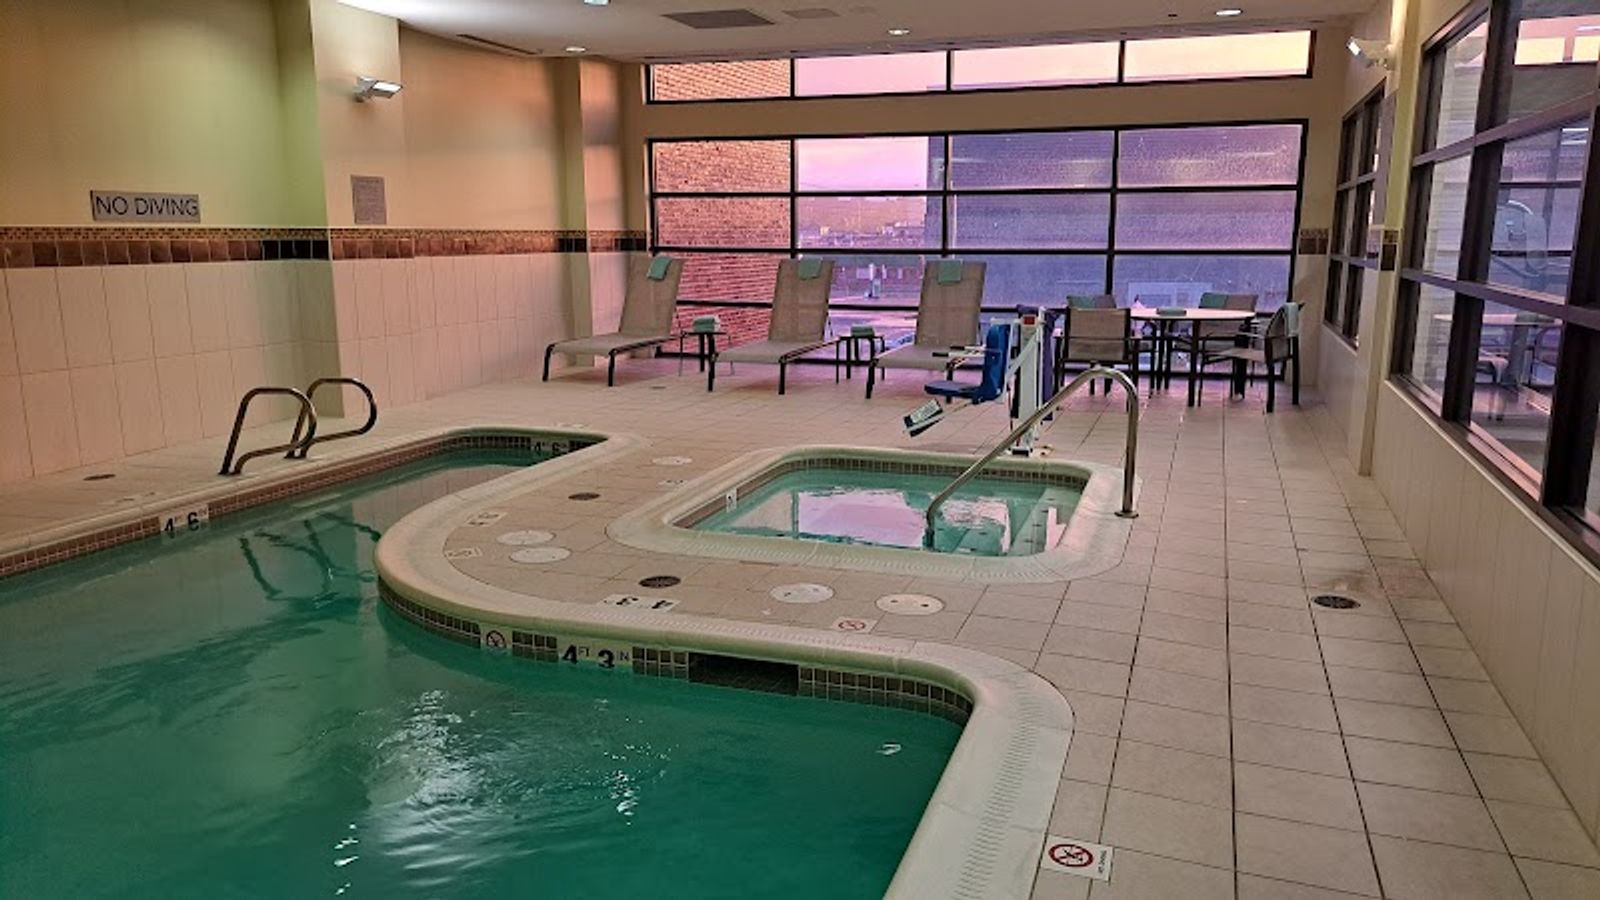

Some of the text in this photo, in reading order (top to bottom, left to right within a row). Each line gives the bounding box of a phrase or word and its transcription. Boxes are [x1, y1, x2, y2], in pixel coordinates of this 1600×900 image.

[96, 195, 199, 217] NO DIVING
[188, 511, 200, 531] 6
[562, 644, 577, 664] 4
[598, 649, 615, 668] 3
